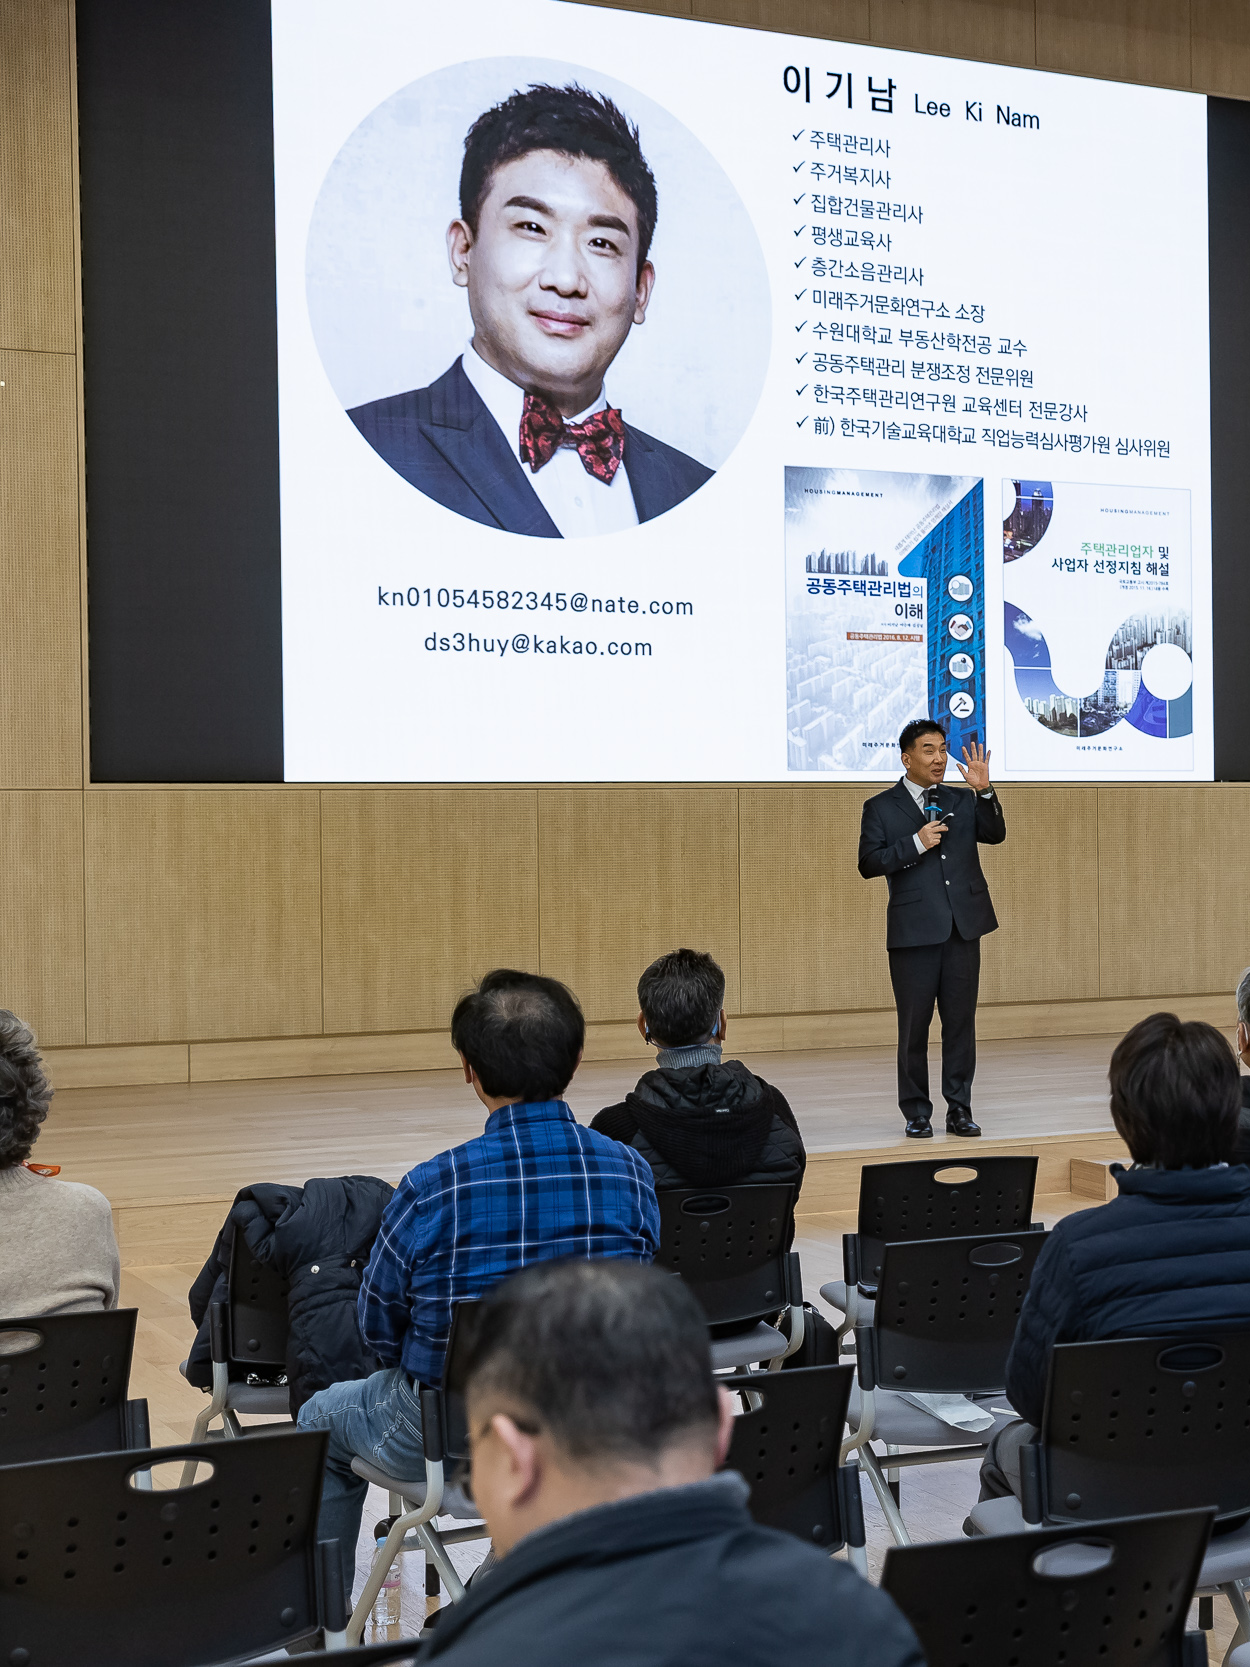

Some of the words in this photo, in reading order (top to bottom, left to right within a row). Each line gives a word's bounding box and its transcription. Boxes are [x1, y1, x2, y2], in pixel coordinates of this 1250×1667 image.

[915, 94, 950, 117] Lee
[965, 101, 982, 122] Ki
[996, 105, 1040, 129] Nam
[810, 130, 891, 158] 주택관리사
[810, 162, 891, 189] 주거복지사
[811, 194, 923, 224] 집합건물관리사
[811, 226, 892, 252] 평생교육사
[811, 257, 924, 286] 층간소음관리사
[813, 290, 950, 318] 미래주거문화연구소
[955, 304, 985, 323] 소장
[813, 322, 893, 344] 수원대학교
[899, 329, 992, 354] 부동산학전공
[998, 338, 1027, 357] 교수
[813, 353, 905, 378] 공동주택관리
[911, 361, 970, 383] 분쟁조정
[976, 366, 1033, 388] 전문위원
[814, 384, 956, 413] 한국주택관리연구원
[962, 396, 1022, 418] 교육센터
[1029, 401, 1088, 422] 전문강사
[814, 416, 835, 436] 前)
[841, 418, 976, 444] 한국기술교육대학교
[982, 428, 1110, 454] 직업능력심사평가원
[1116, 438, 1170, 458] 심사위원
[1081, 542, 1154, 558] 주택관리업자
[1159, 546, 1168, 560] 및
[1052, 558, 1088, 572] 사업자
[1094, 560, 1140, 575] 선정지침
[1146, 562, 1169, 576] 해설
[378, 586, 694, 615] kn01054582345@nate.com
[806, 578, 923, 598] 공동주택관리법의
[895, 603, 923, 619] 이해
[424, 632, 652, 656] ds3huy@kakao.com
